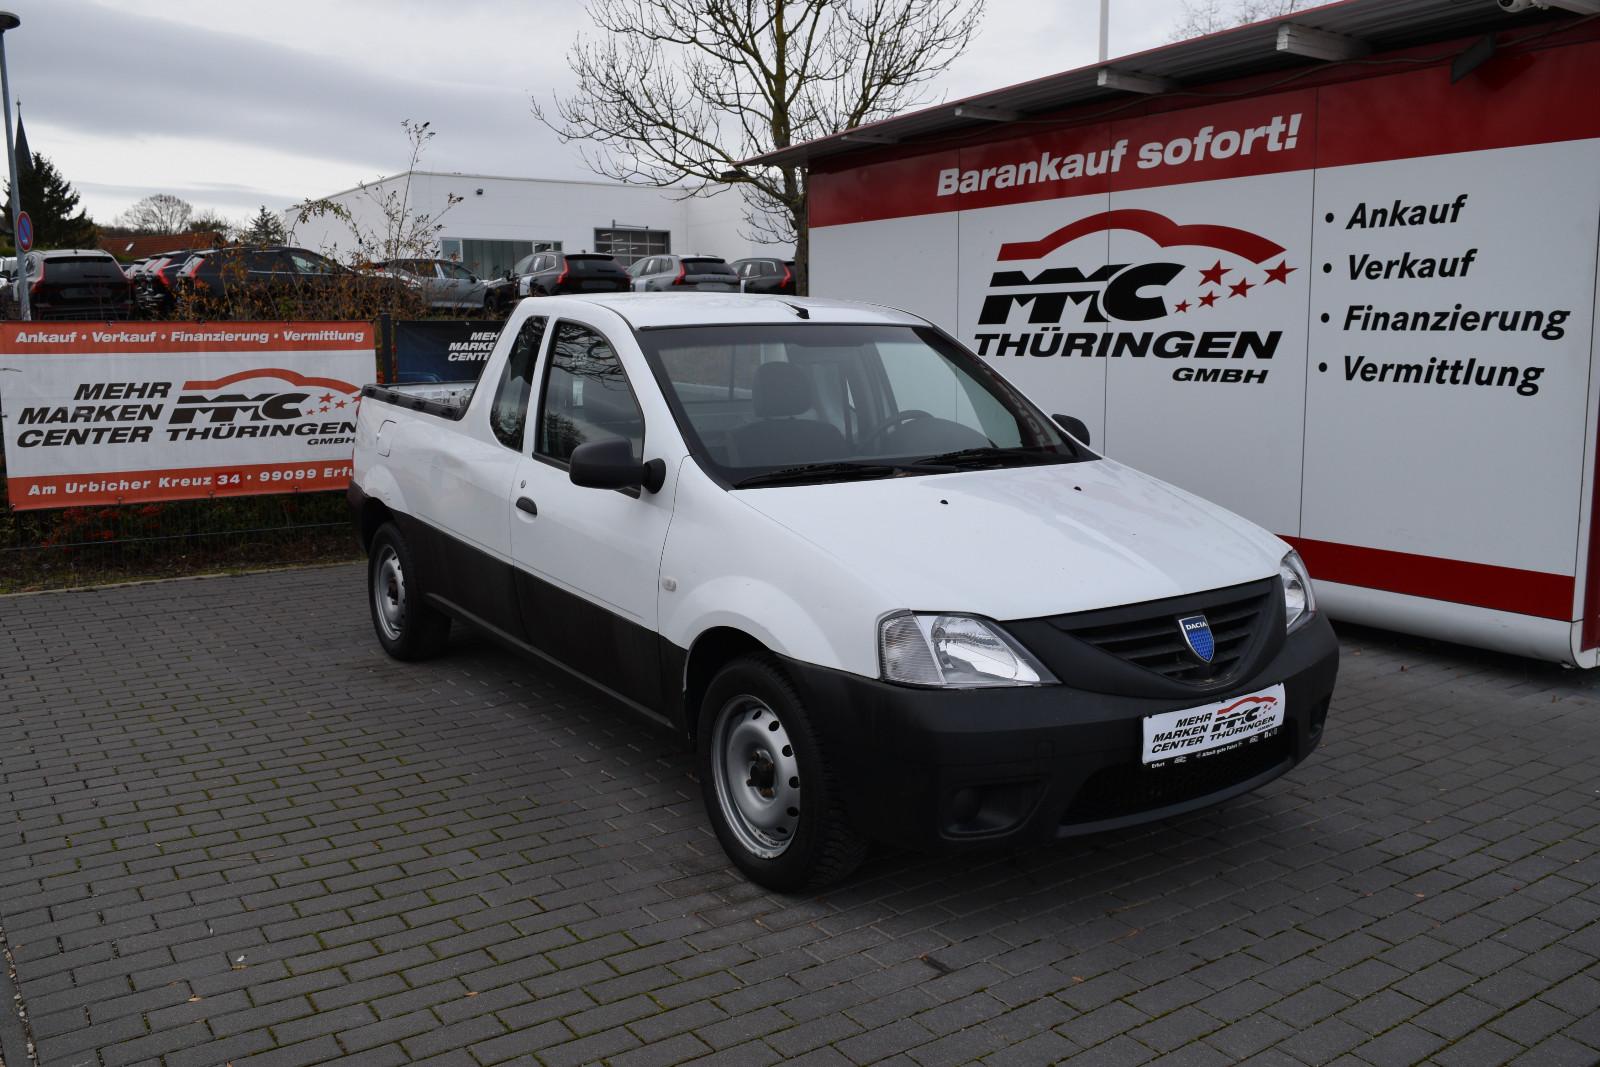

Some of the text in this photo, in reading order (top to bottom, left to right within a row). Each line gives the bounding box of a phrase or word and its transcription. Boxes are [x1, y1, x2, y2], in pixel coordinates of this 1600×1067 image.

[937, 113, 1302, 196] Barankauf sofort!
[1345, 193, 1468, 230] Ankauf
[1348, 248, 1478, 281] Verkauf
[1343, 303, 1571, 341] Finanzierung
[15, 330, 364, 344] Ankauf Verkauf Finanzierung Vermittlung
[448, 342, 495, 351] MARKE
[470, 332, 500, 341] MEH
[973, 327, 1283, 359] THÜRINGEN
[447, 352, 490, 361] CENT
[1171, 367, 1268, 384] GMBH
[1343, 355, 1545, 397] Vermittlung
[73, 381, 172, 401] MEHR
[17, 403, 164, 425] MARKEN
[17, 425, 153, 448] CENTER
[166, 421, 357, 442] THÜRINGEN
[307, 437, 355, 446] GMBH
[28, 484, 56, 496] Am
[65, 479, 151, 493] Urbicher
[159, 476, 212, 488] Kreuz
[217, 473, 241, 486] 34
[259, 469, 317, 482] 99099
[1185, 621, 1208, 630] DACIA
[1176, 712, 1213, 728] MEHR
[1210, 715, 1275, 741] THÜRINGEN
[1153, 724, 1209, 743] MARKEN
[1151, 735, 1205, 754] CENTER
